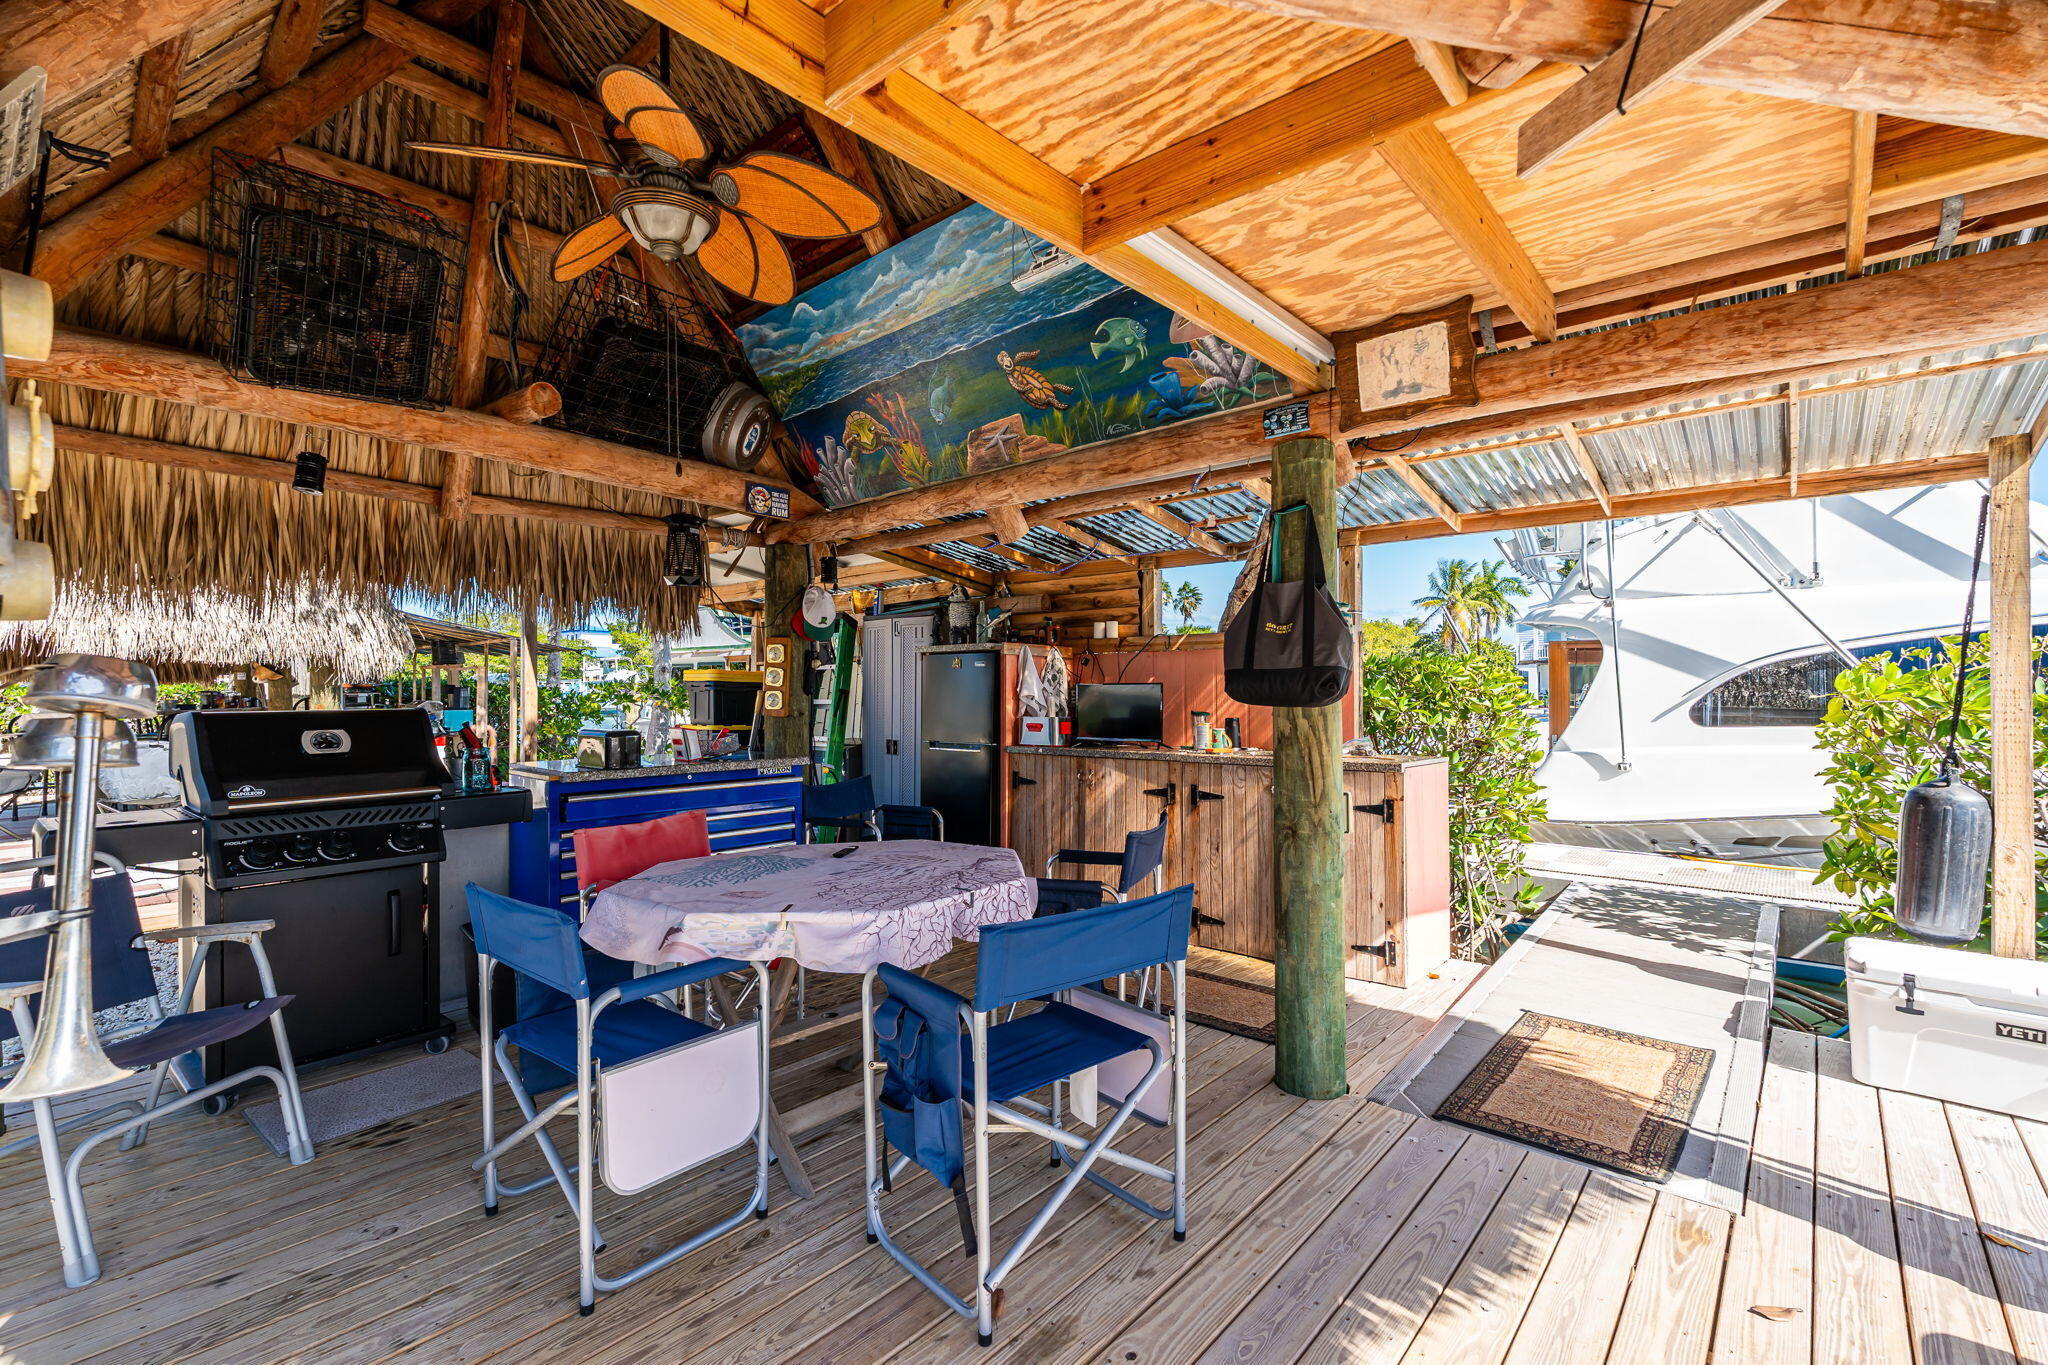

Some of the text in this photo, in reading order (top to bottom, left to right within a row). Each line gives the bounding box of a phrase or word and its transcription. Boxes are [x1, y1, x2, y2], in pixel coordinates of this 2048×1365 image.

[771, 507, 789, 518] RUM
[765, 766, 792, 774] YUKON
[230, 790, 264, 798] NAPOLEON
[1998, 1024, 2043, 1042] YETI
